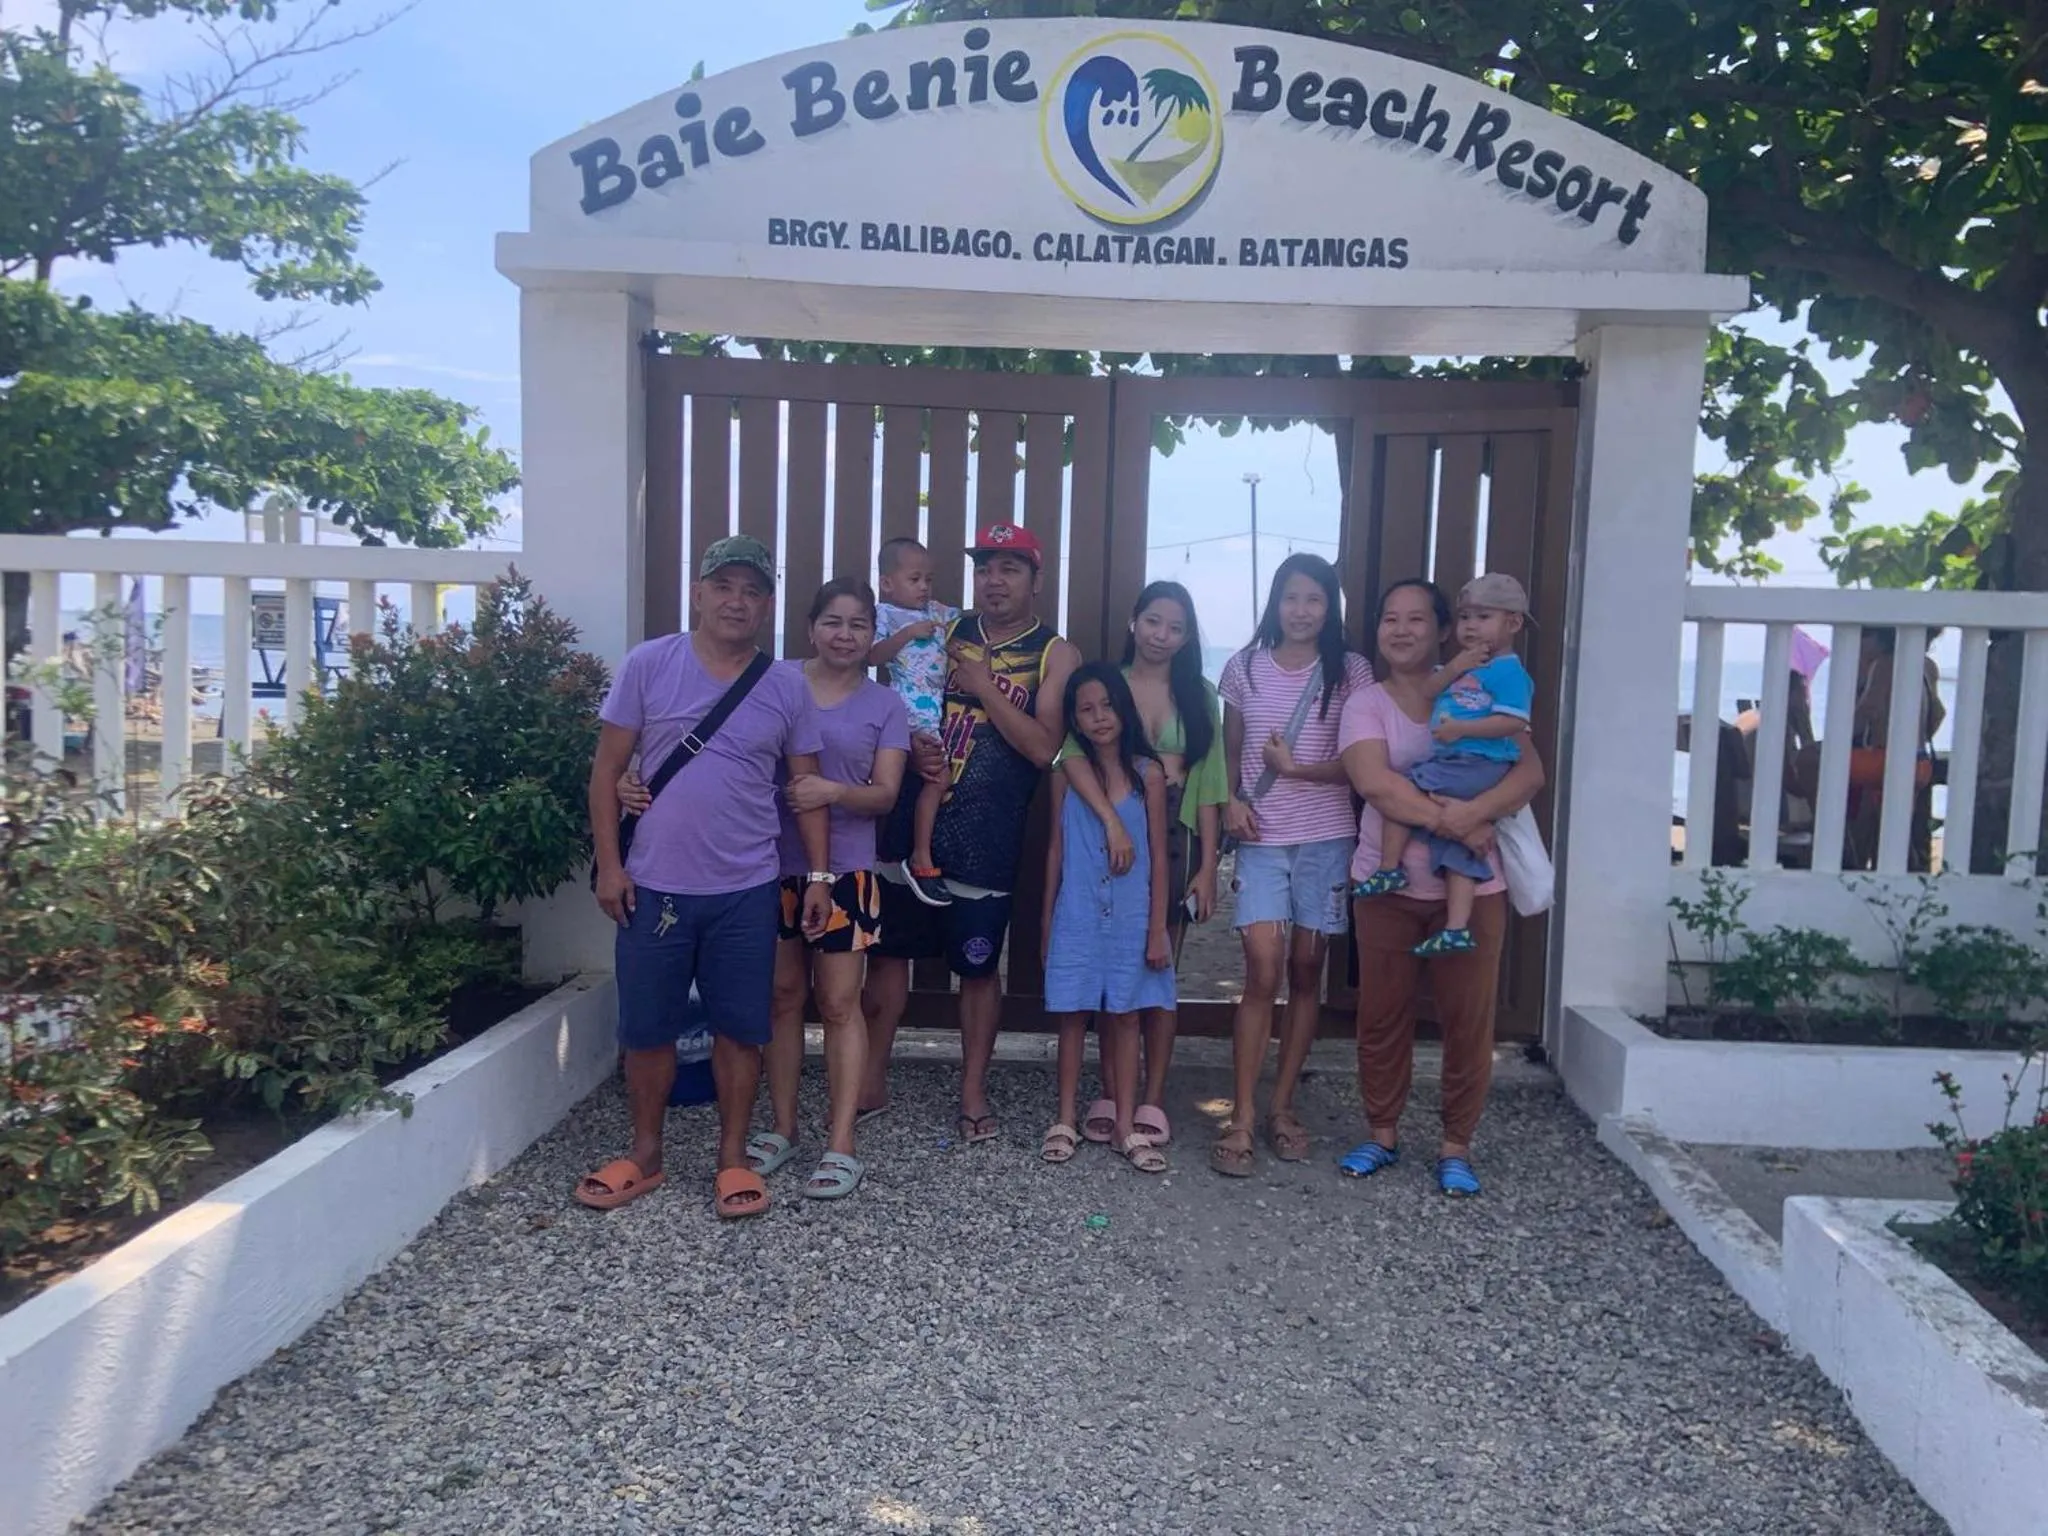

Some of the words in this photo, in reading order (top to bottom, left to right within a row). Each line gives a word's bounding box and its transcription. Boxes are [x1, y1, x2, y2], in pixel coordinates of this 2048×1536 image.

[570, 93, 766, 215] Baie
[782, 27, 1038, 137] Benie
[1232, 46, 1450, 153] Beach
[1453, 97, 1654, 246] Resort
[767, 218, 852, 250] BRGY.
[1239, 238, 1410, 269] BATANGAS
